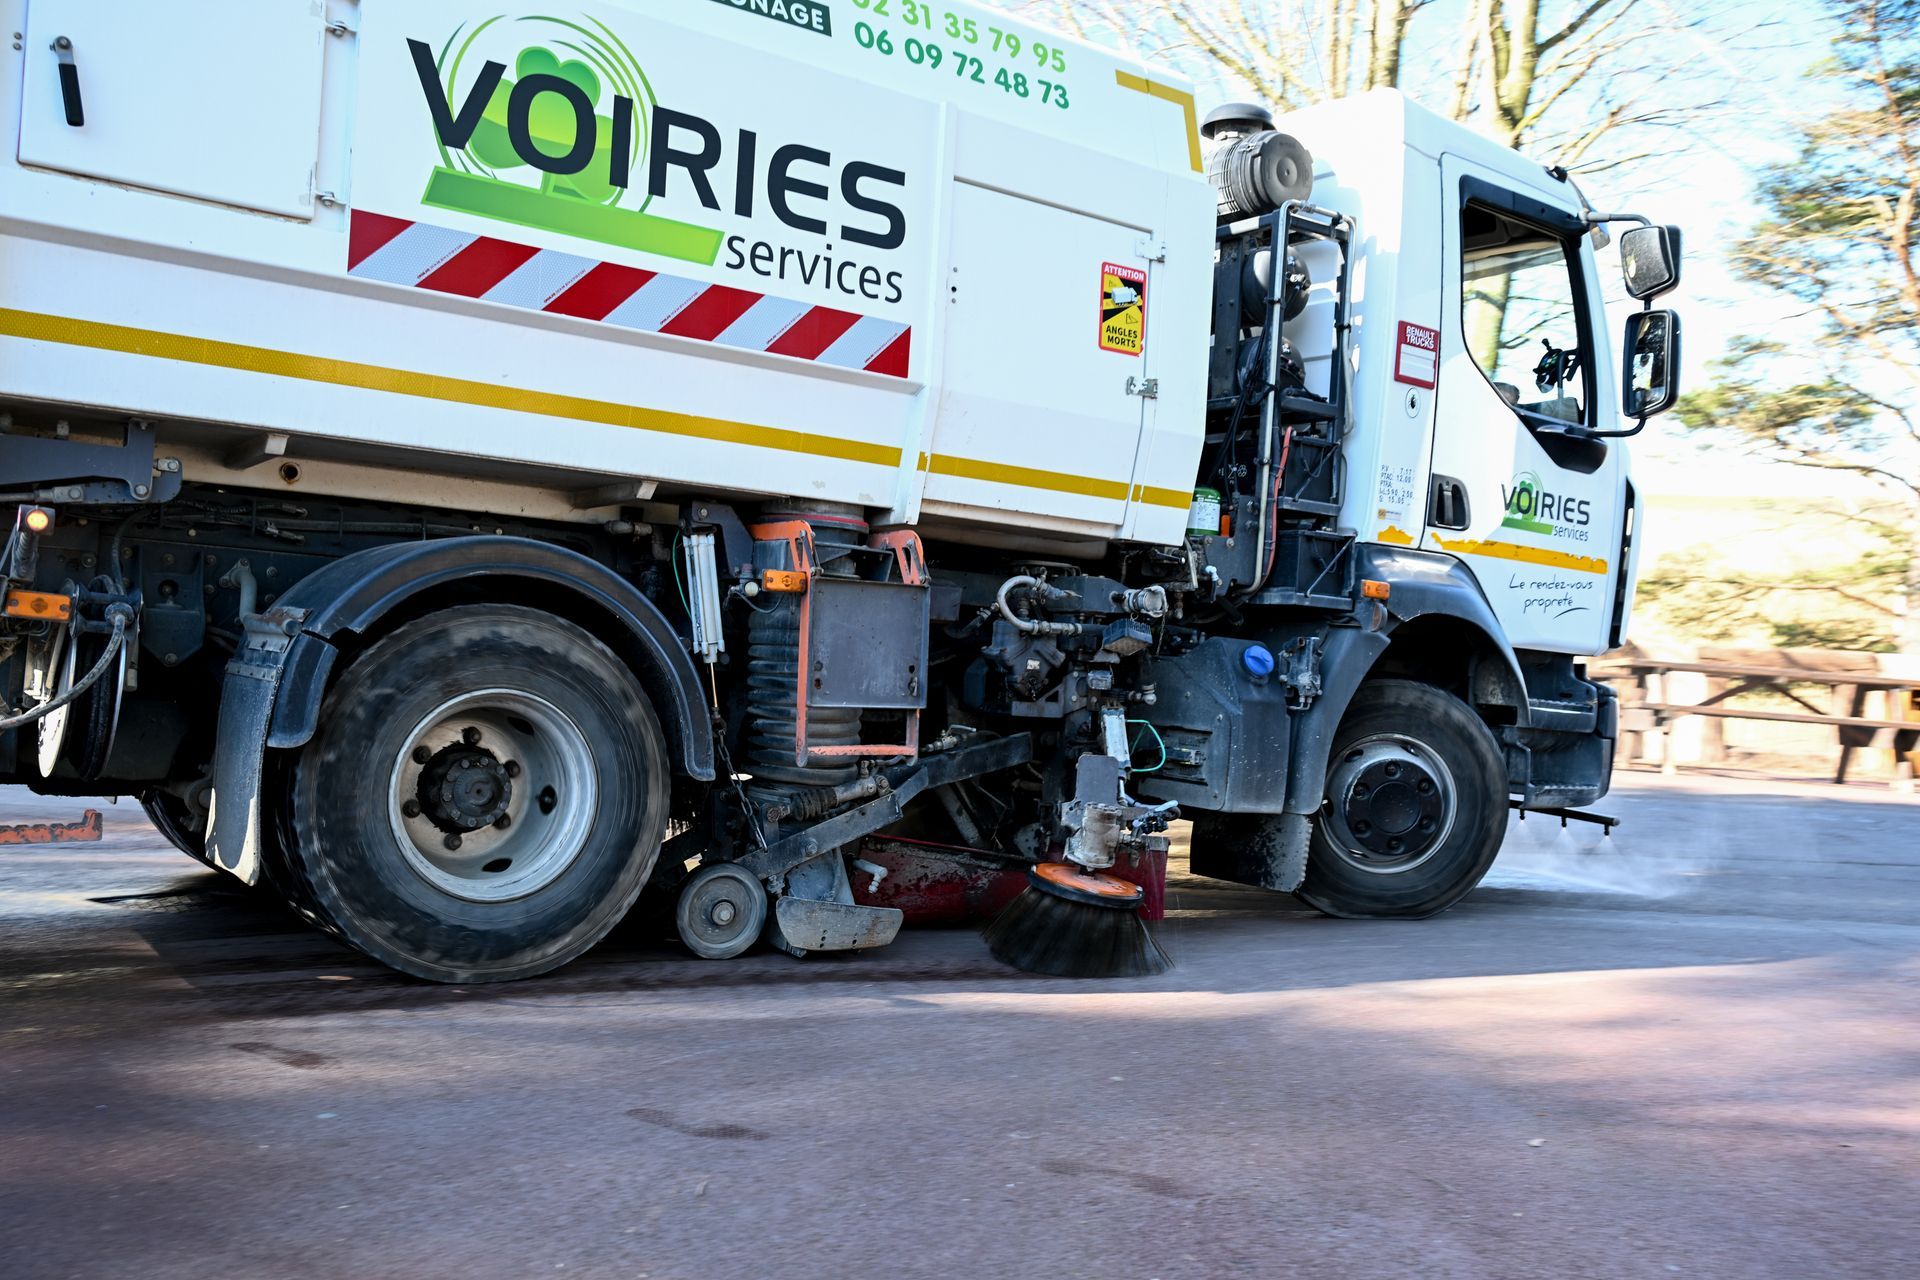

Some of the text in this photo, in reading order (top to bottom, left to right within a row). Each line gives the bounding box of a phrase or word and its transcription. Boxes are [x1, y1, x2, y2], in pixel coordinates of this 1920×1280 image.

[901, 0, 931, 31] 31
[944, 12, 978, 44] 35
[988, 27, 1021, 58] 79
[1032, 42, 1066, 73] 95
[854, 22, 1070, 109] 06 09 72 48 73
[406, 37, 907, 250] VOIRIES
[725, 234, 903, 304] services
[1104, 264, 1145, 281] ATTENTION
[1106, 325, 1138, 339] ANGLES
[1406, 325, 1435, 340] RENAULT
[1107, 335, 1136, 348] MORTS
[1406, 334, 1435, 349] TRUCKS
[1501, 484, 1590, 526] VOIRIES
[1554, 524, 1589, 542] services
[1509, 573, 1593, 590] Le rendez-vous
